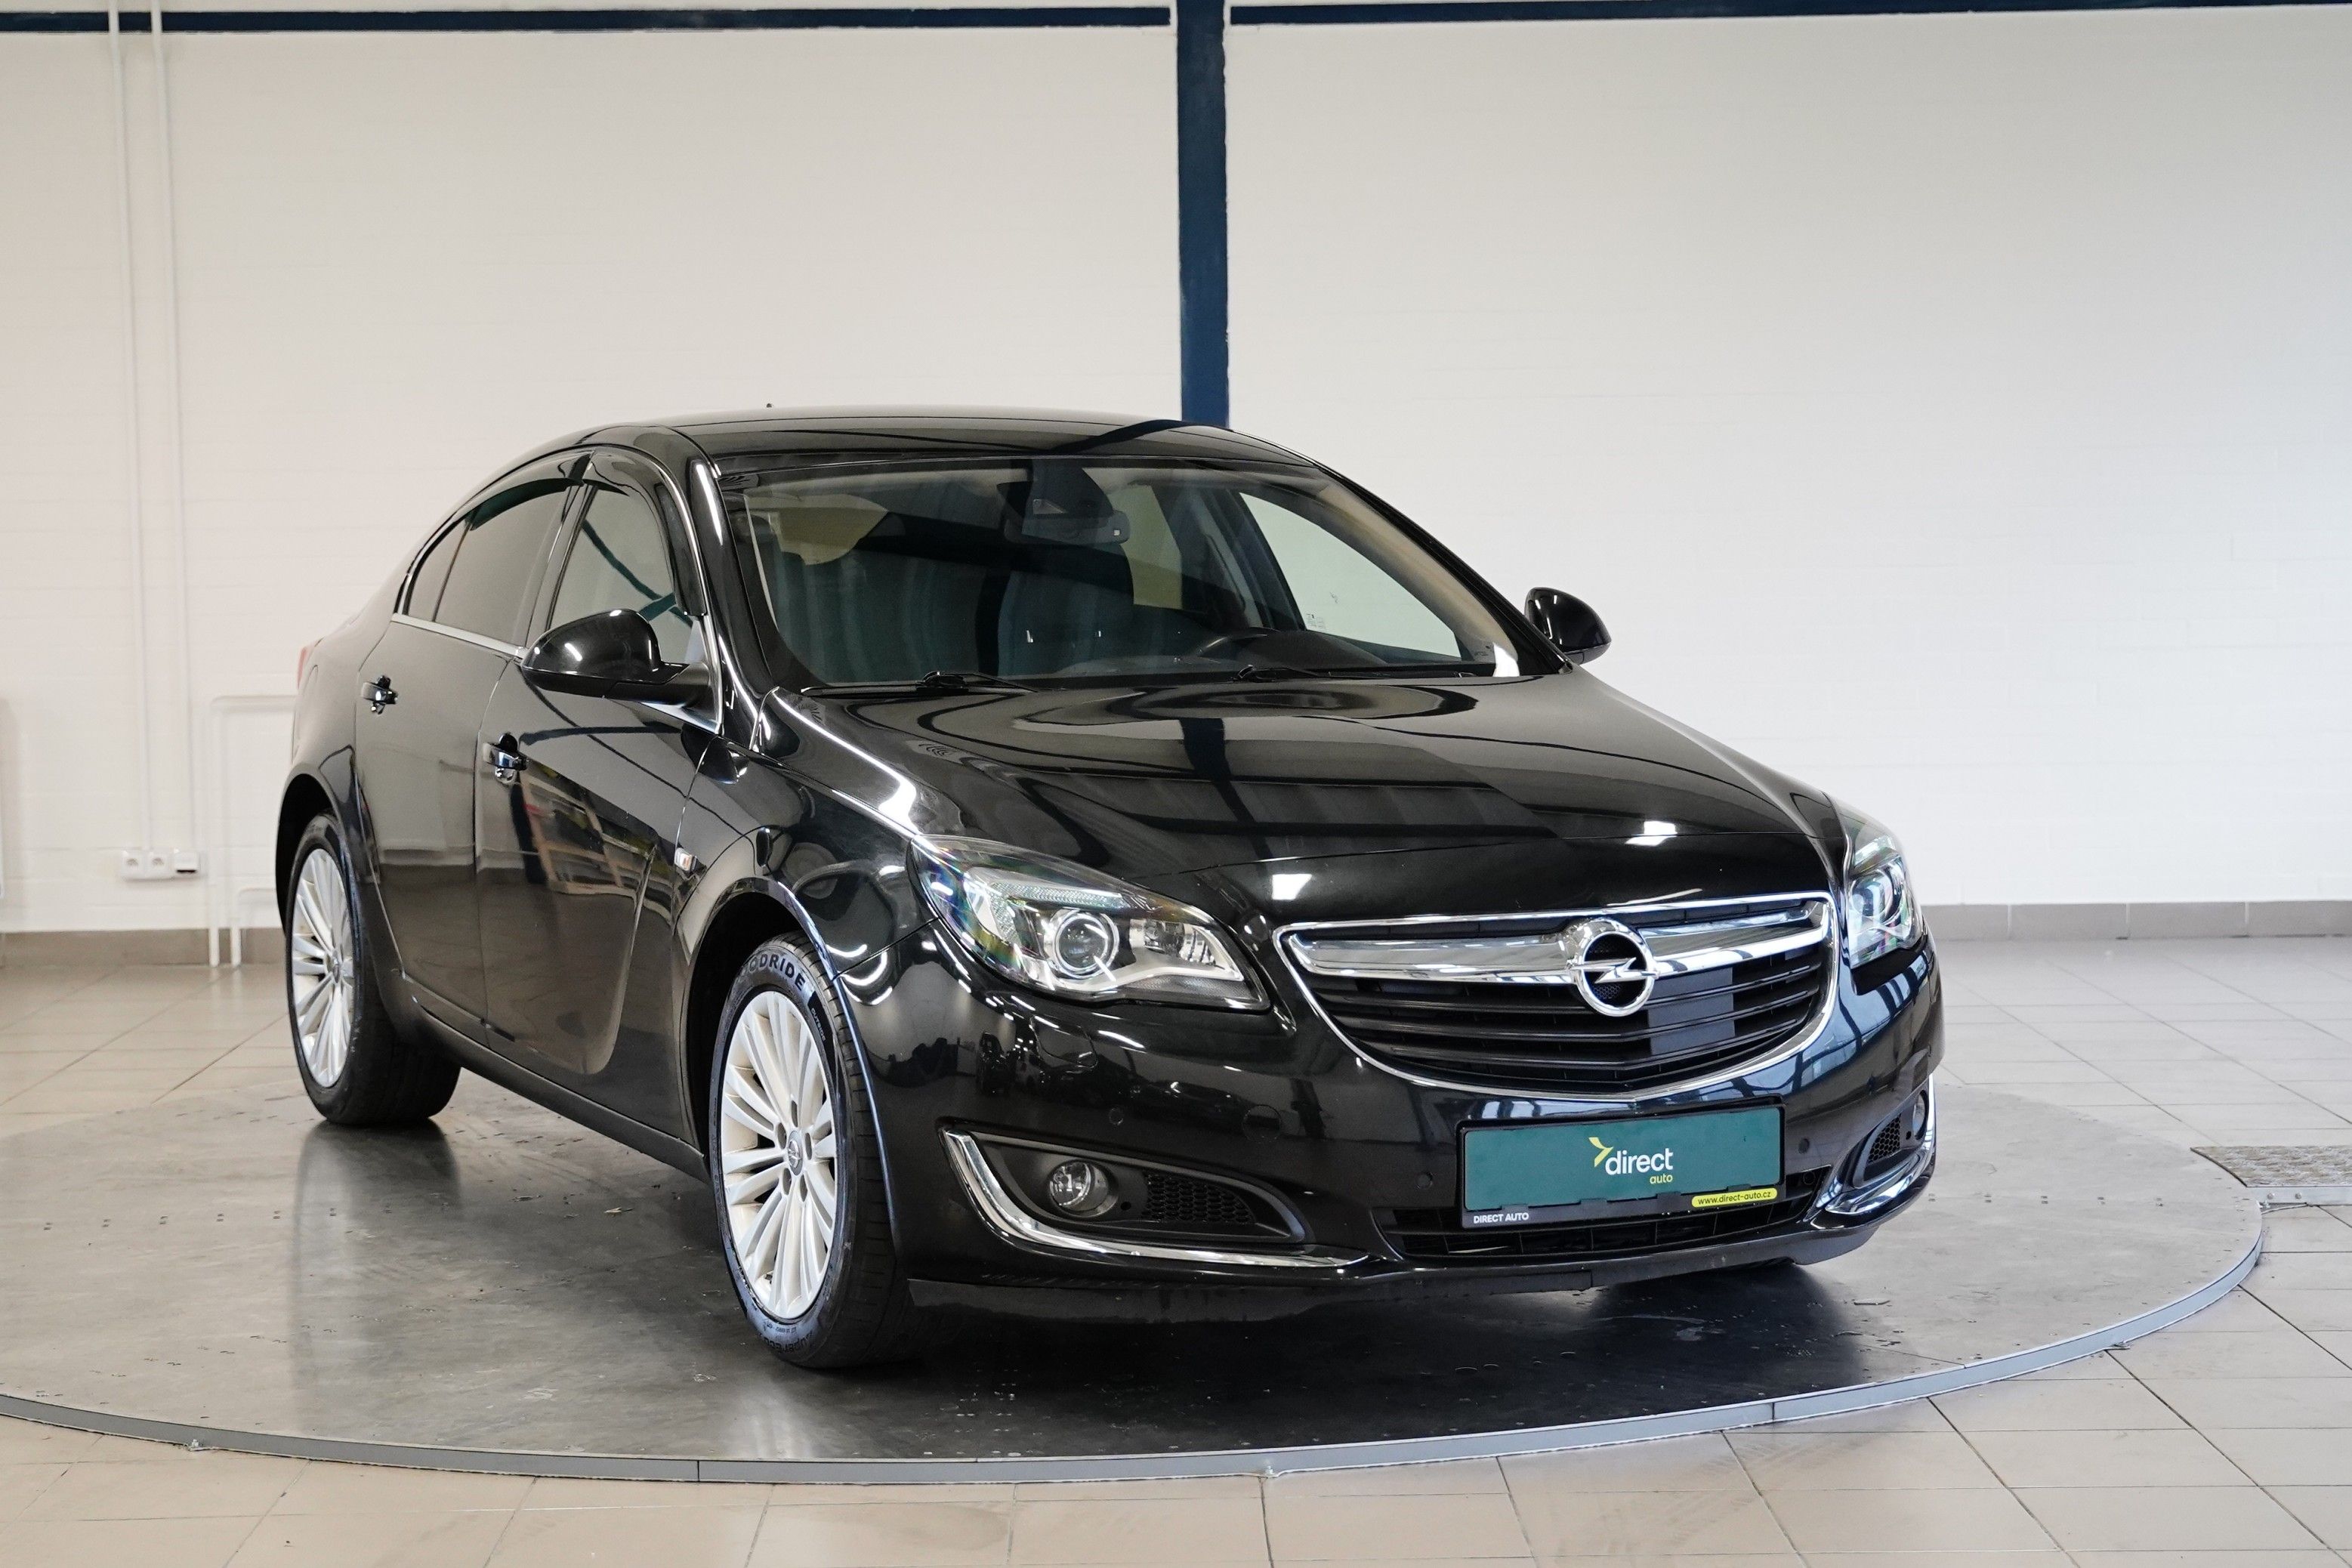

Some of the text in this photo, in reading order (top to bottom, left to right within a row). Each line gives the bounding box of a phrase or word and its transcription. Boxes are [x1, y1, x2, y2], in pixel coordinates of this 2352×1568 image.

[1605, 1148, 1674, 1175] direct
[1650, 1174, 1673, 1184] auto
[1697, 1190, 1771, 1205] www.direct-auto.cz
[1473, 1212, 1529, 1224] DIRECT AUTO
